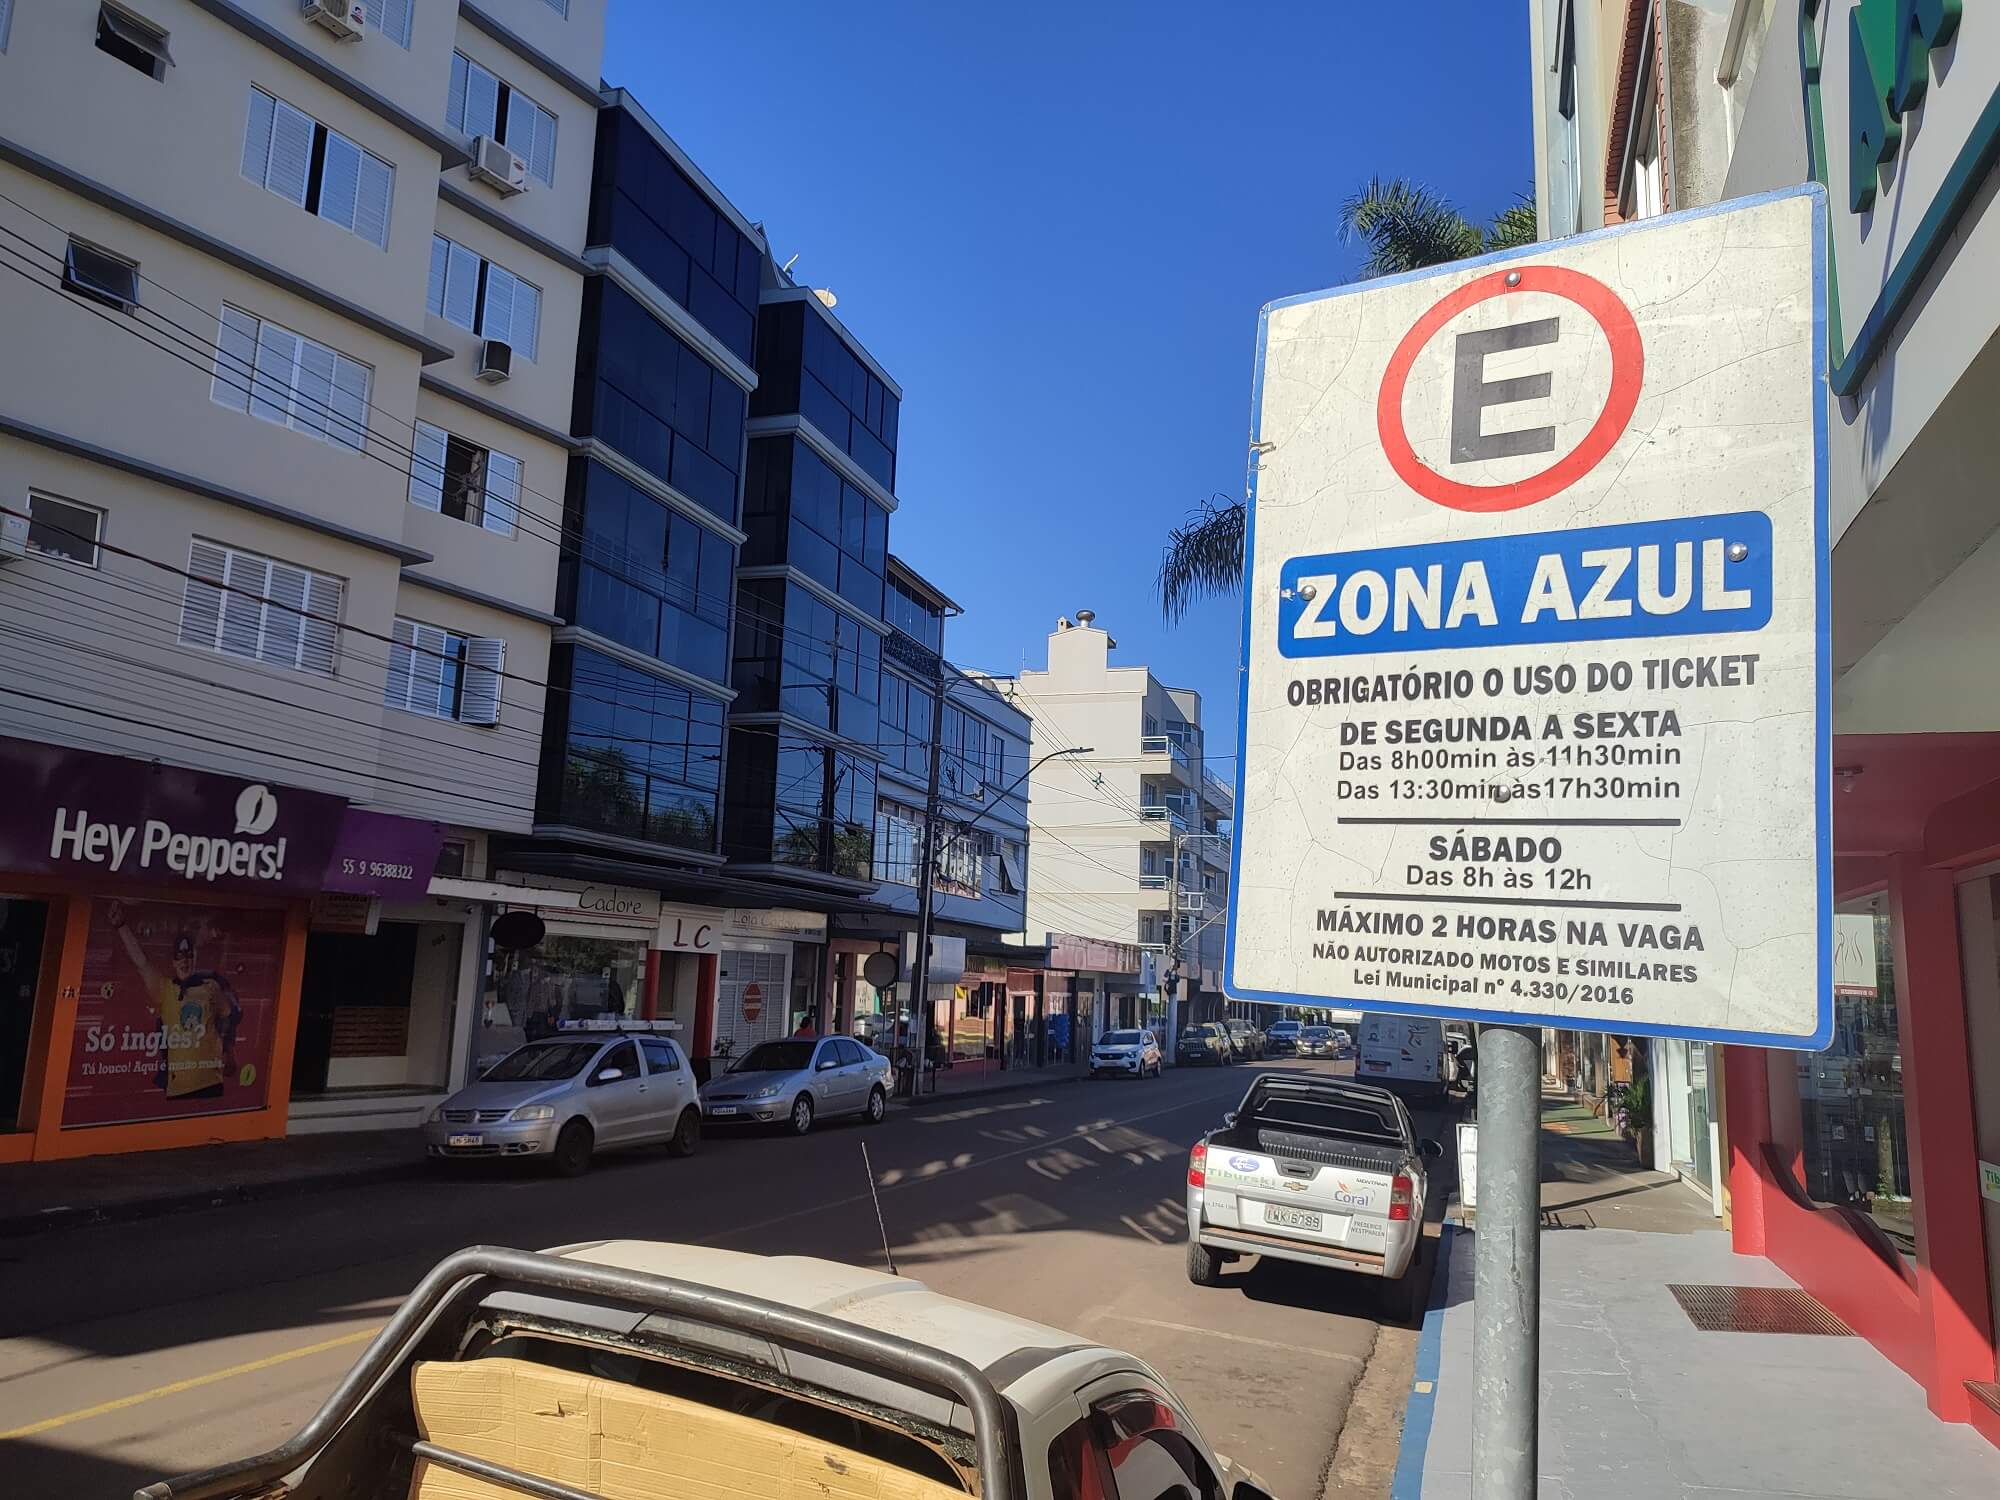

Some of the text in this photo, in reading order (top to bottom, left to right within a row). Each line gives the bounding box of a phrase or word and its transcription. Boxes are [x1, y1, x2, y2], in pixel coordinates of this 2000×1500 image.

[1450, 317, 1559, 464] E
[1293, 538, 1751, 640] ZONA AZUL
[1287, 654, 1760, 707] OBRIGATÓRIO O USO DO TICKET
[1340, 710, 1682, 745] DE SEGUNDA A SEXTA
[1339, 743, 1682, 771] Das 8h00min às 11h30min
[1337, 780, 1379, 800] Das
[1511, 778, 1541, 800] às
[1544, 776, 1681, 800] 17h30min
[50, 807, 287, 881] Hey Peppers!
[1429, 829, 1562, 864] SÁBADO
[342, 858, 355, 874] 55
[359, 860, 367, 875] 9
[1406, 865, 1592, 890] Das 8h às 12h
[578, 886, 643, 915] Cadore
[1316, 905, 1705, 952] MÁXIMO 2 HORAS NA VAGA
[1312, 940, 1698, 984] NÃO AUTORIZADO MOTOS E SIMILARES
[1353, 969, 1380, 987] Lei
[1386, 970, 1479, 996] Municipal
[1510, 978, 1635, 1005] 4.330/2016
[85, 1025, 116, 1053] Só
[1334, 1190, 1369, 1207] Coral
